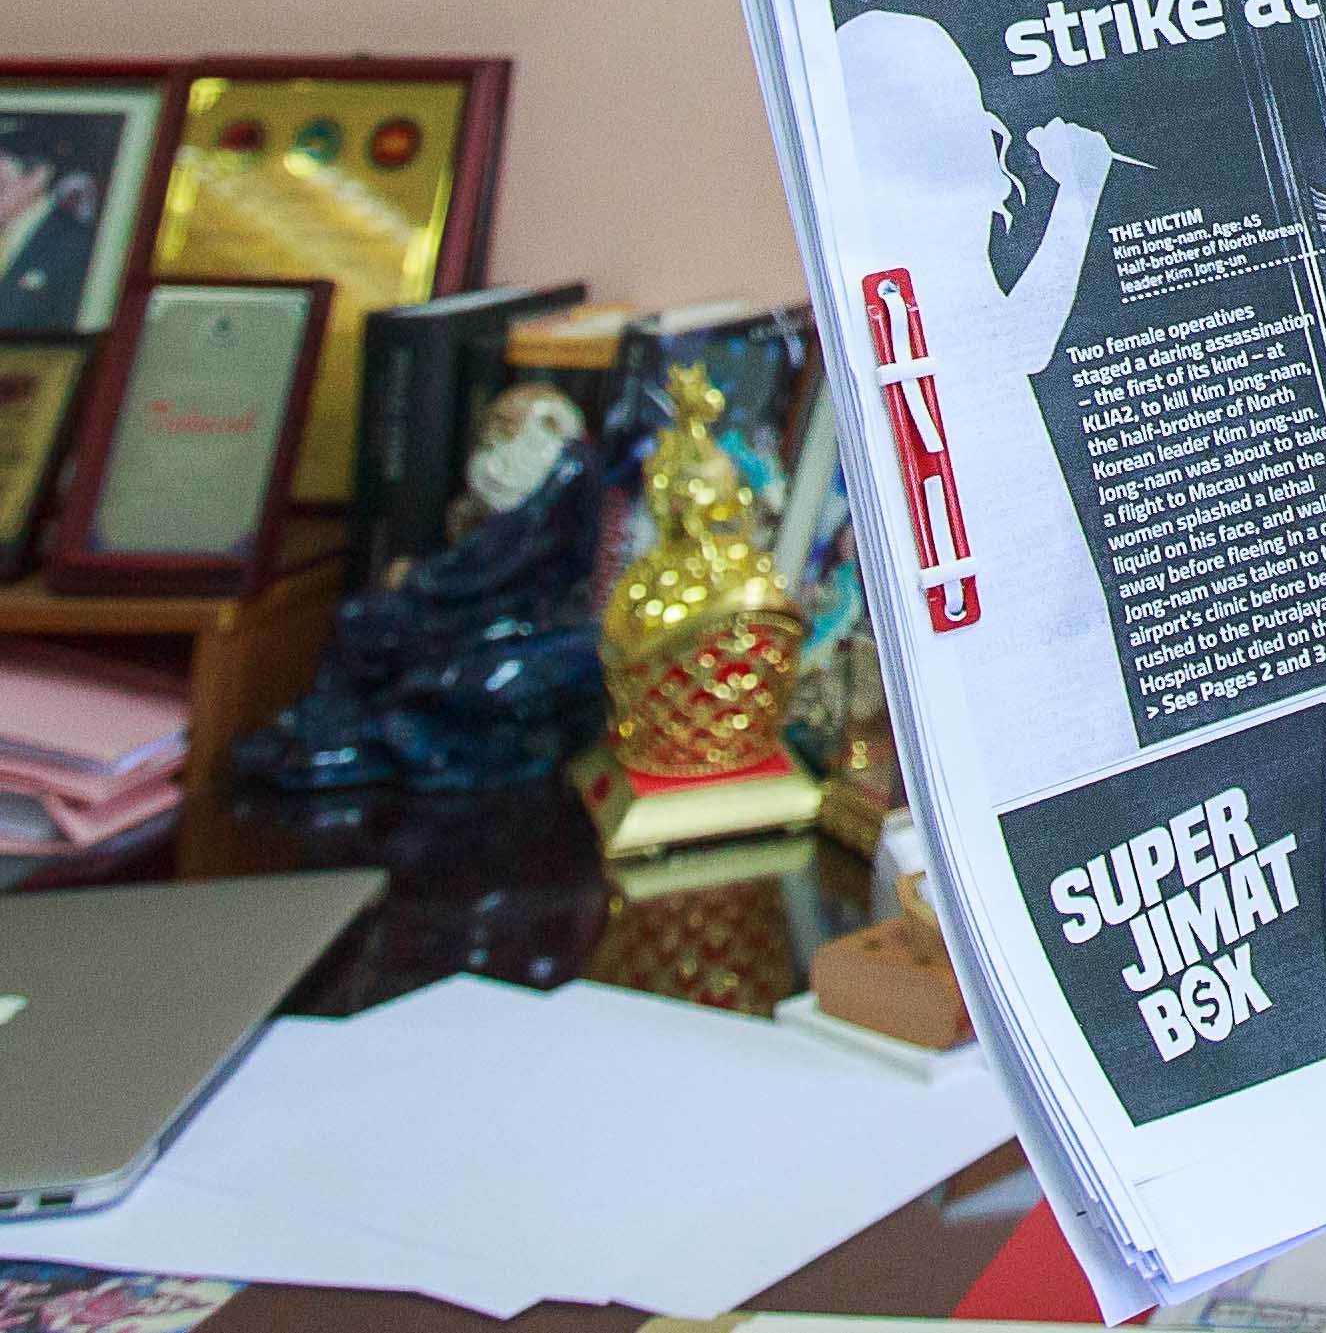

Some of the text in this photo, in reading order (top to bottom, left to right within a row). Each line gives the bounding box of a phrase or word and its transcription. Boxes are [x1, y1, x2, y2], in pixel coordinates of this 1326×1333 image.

[1107, 207, 1203, 242] THE VICTIM
[1112, 213, 1261, 259] Kim Jong-nam. Age: 45
[1116, 222, 1305, 277] Half-brother of North Korean
[1120, 254, 1247, 293] leader Kim Jong-un
[1067, 305, 1255, 363] Two female operatives
[1072, 309, 1315, 387] staged a daring assassination
[1082, 361, 1311, 433] KLIA2, to kill Kim Jong-nam,
[1093, 341, 1285, 405] the first of its kind at
[1087, 385, 1295, 456] the half-brother of North
[1092, 406, 1319, 480] Korean leader Kim Jong-un.
[1098, 468, 1182, 505] Jong-nam
[1184, 457, 1221, 478] was
[1223, 440, 1273, 467] about
[1273, 436, 1293, 452] to
[1103, 451, 1325, 527] a flight to Macau when the
[1107, 473, 1315, 550] women splashed a lethal
[1112, 544, 1161, 574] liquid
[1164, 541, 1187, 558] on
[1188, 531, 1216, 551] his
[1218, 520, 1260, 542] face,
[1262, 504, 1294, 529] and
[1118, 572, 1165, 598] away
[1167, 554, 1225, 583] before
[1227, 536, 1286, 565] fleeing
[1286, 529, 1304, 546] in
[1306, 526, 1318, 540] a
[1124, 585, 1209, 624] Jong-nam
[1210, 572, 1247, 594] was
[1249, 557, 1297, 582] taken
[1299, 550, 1318, 566] to
[1129, 610, 1203, 646] airport's
[1204, 595, 1248, 621] clinic
[1249, 579, 1305, 607] before
[1134, 635, 1196, 671] rushed
[1197, 633, 1217, 649] to
[1218, 622, 1250, 643] the
[1139, 655, 1213, 695] Hospital
[1213, 646, 1246, 670] but
[1247, 632, 1285, 659] died
[1287, 628, 1309, 646] on
[1161, 644, 1326, 714] See Pages 2 and 3
[1049, 786, 1259, 945] SUPER
[1121, 832, 1299, 994] JIMAT
[1137, 942, 1273, 1063] BOX
